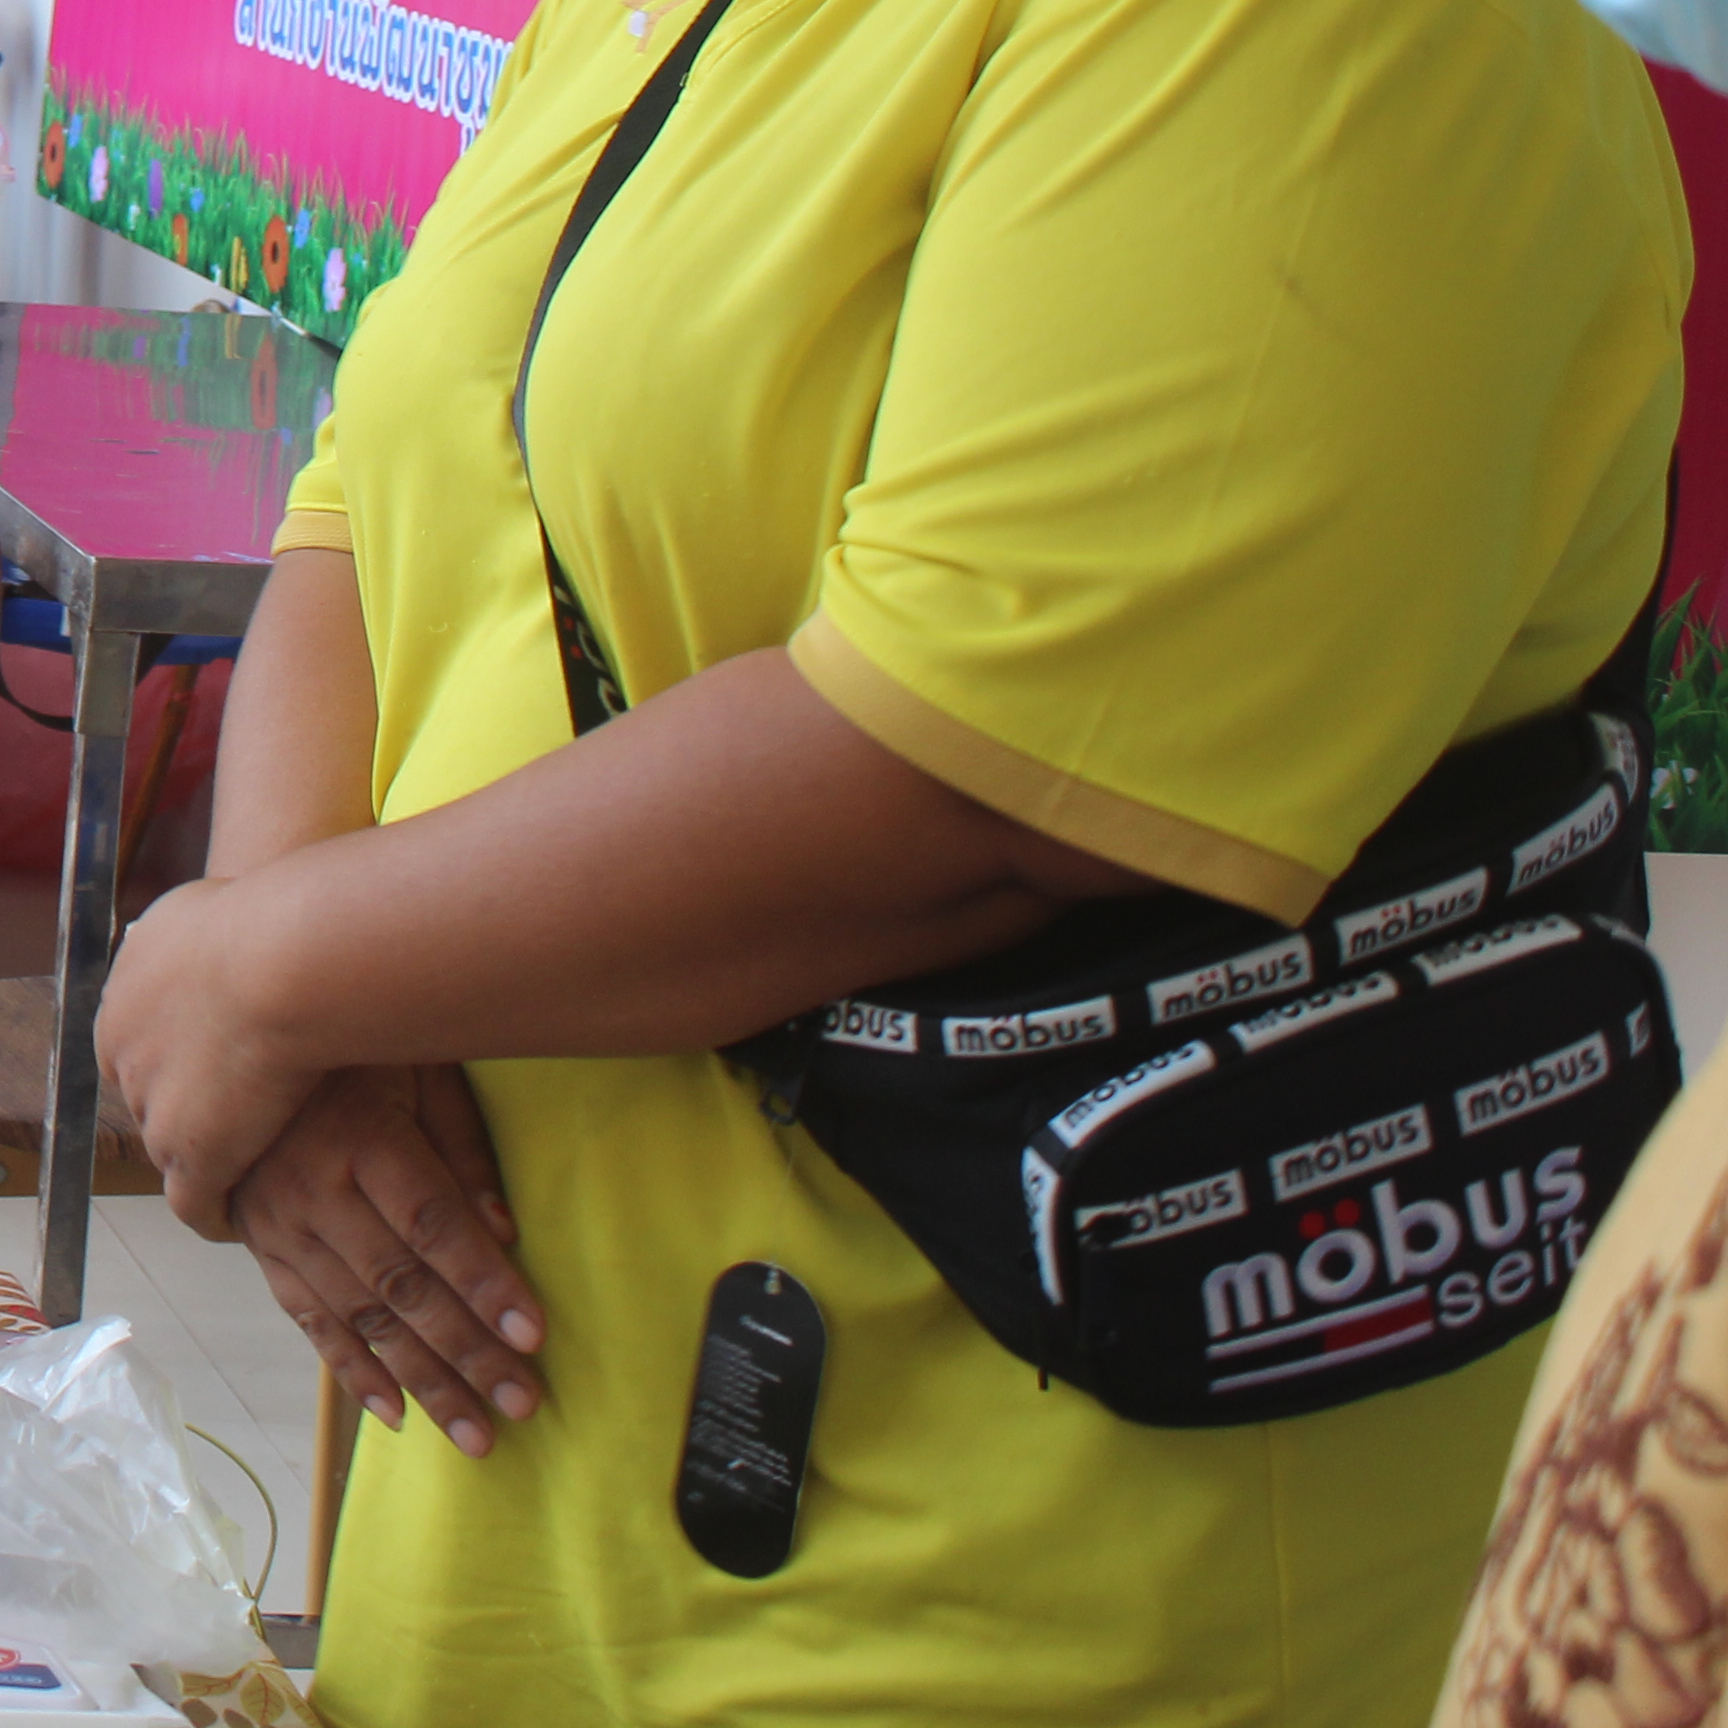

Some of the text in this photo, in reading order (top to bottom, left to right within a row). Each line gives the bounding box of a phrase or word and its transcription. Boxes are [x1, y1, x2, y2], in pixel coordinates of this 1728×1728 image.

[1162, 950, 1303, 1019] möbus
[1349, 883, 1478, 956] möbus
[1517, 802, 1617, 885] möbus
[1201, 1146, 1586, 1339] möbus
[1437, 1214, 1586, 1330] seit
